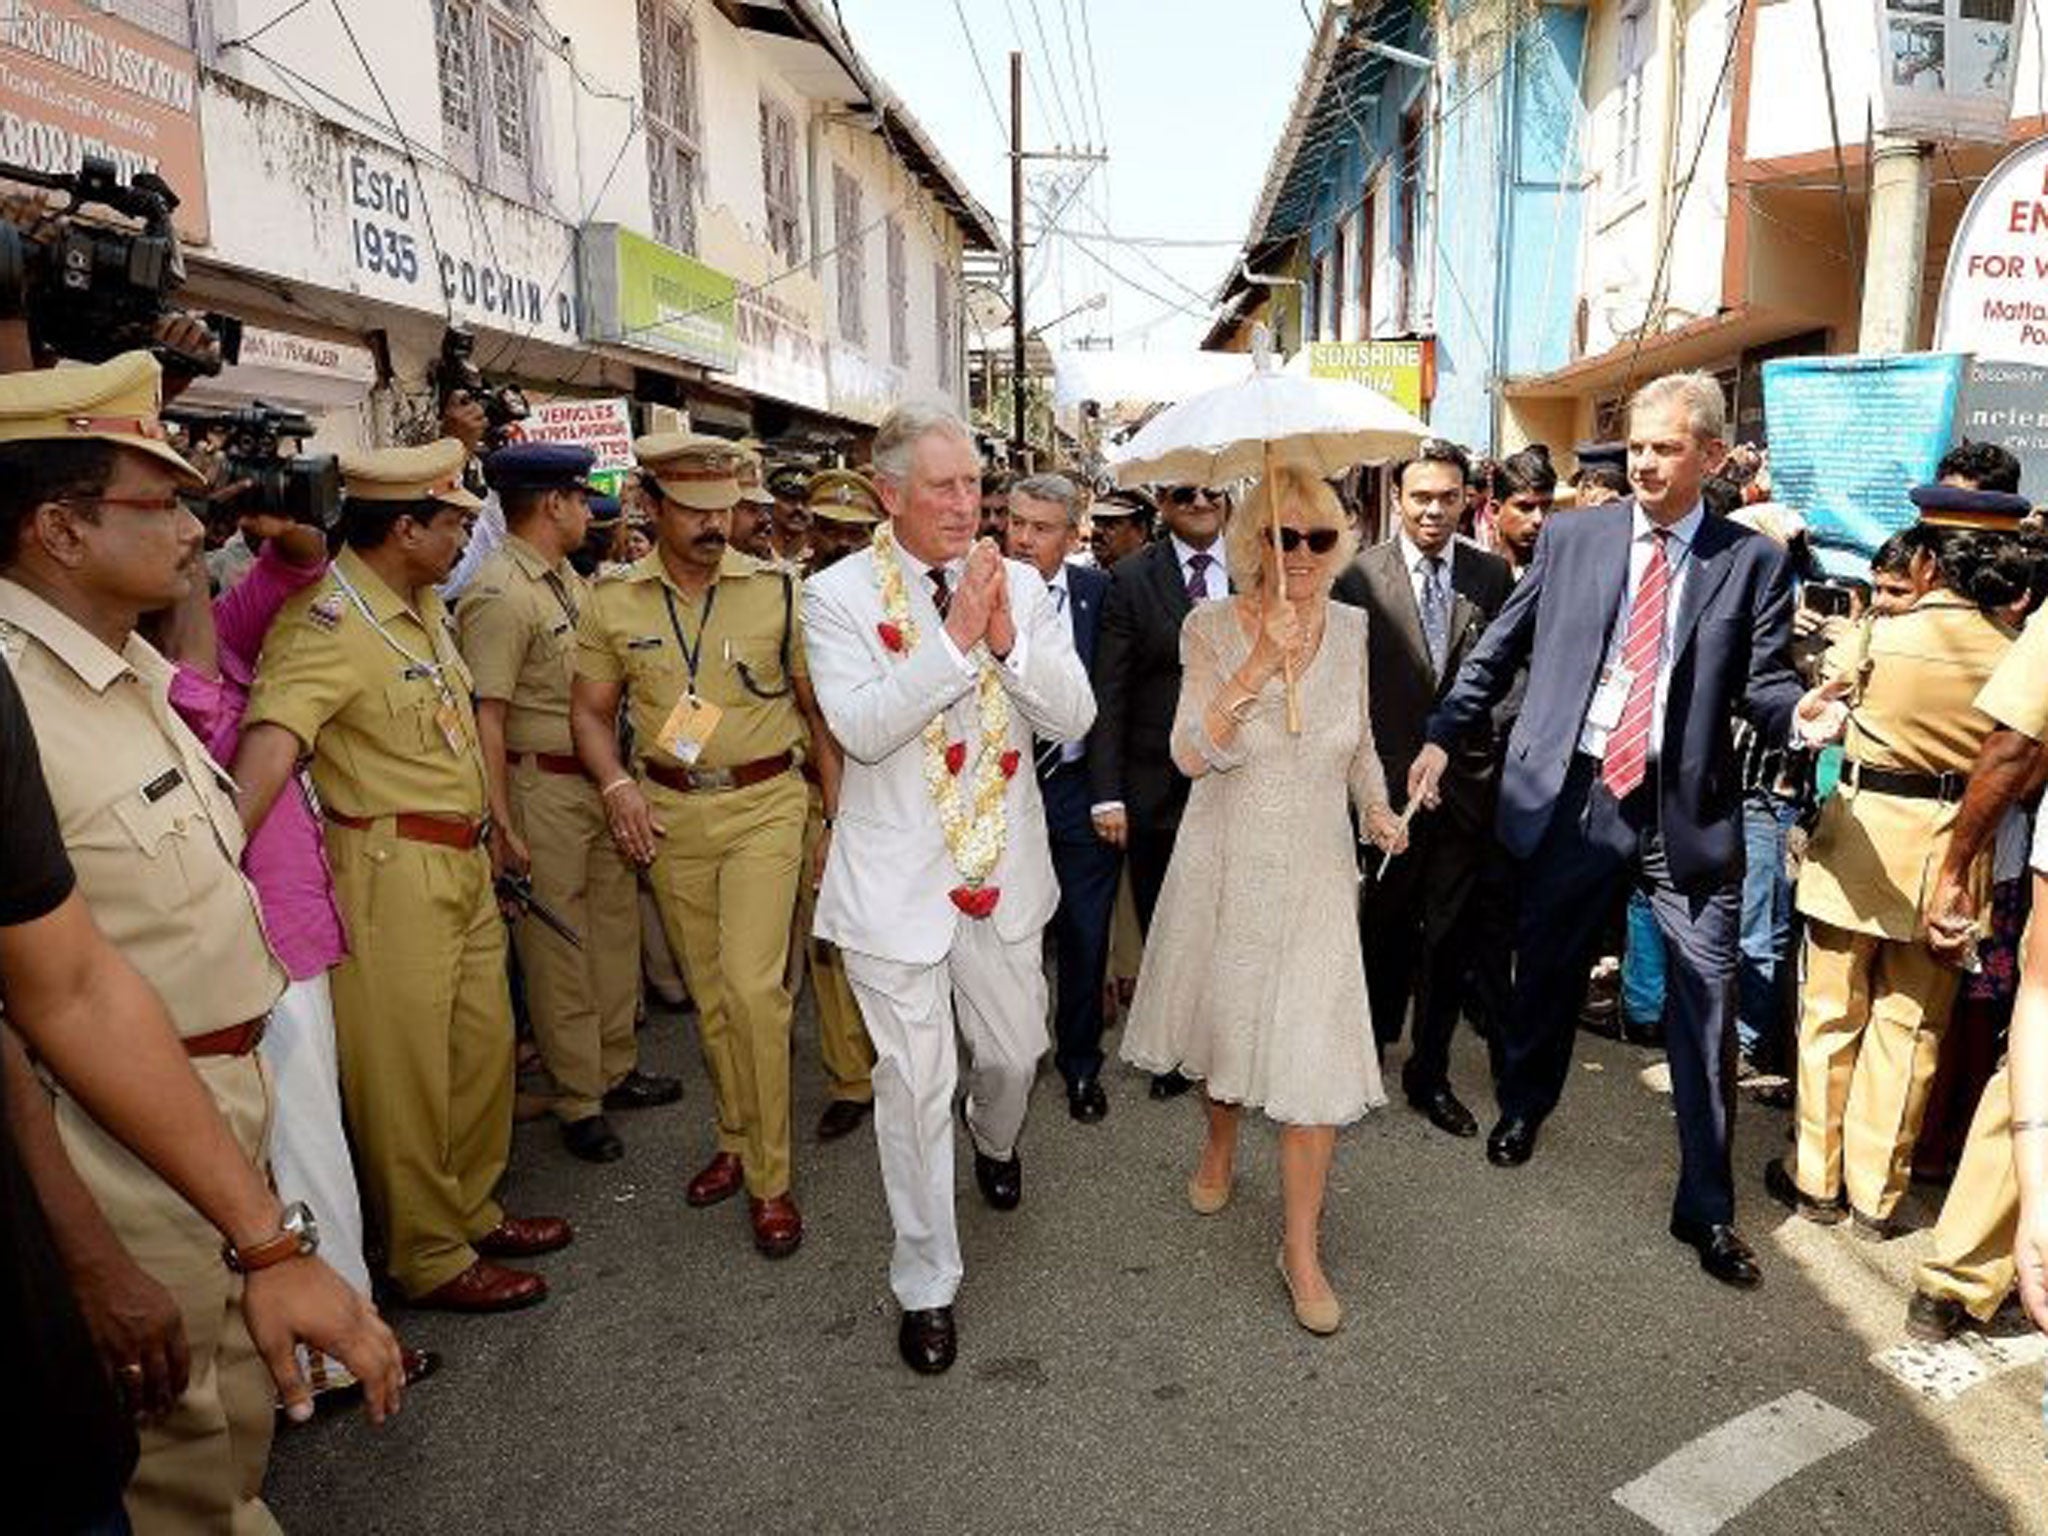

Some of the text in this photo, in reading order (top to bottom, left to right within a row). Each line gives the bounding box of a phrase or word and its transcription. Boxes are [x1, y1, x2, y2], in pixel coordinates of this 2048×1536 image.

[352, 218, 418, 284] 1935
[1967, 254, 2024, 279] FOR
[440, 253, 543, 323] COCHIN
[1982, 297, 2048, 323] Matta
[2020, 324, 2048, 346] Po
[538, 404, 615, 424] VEHICLES
[1964, 409, 2048, 428] ncien
